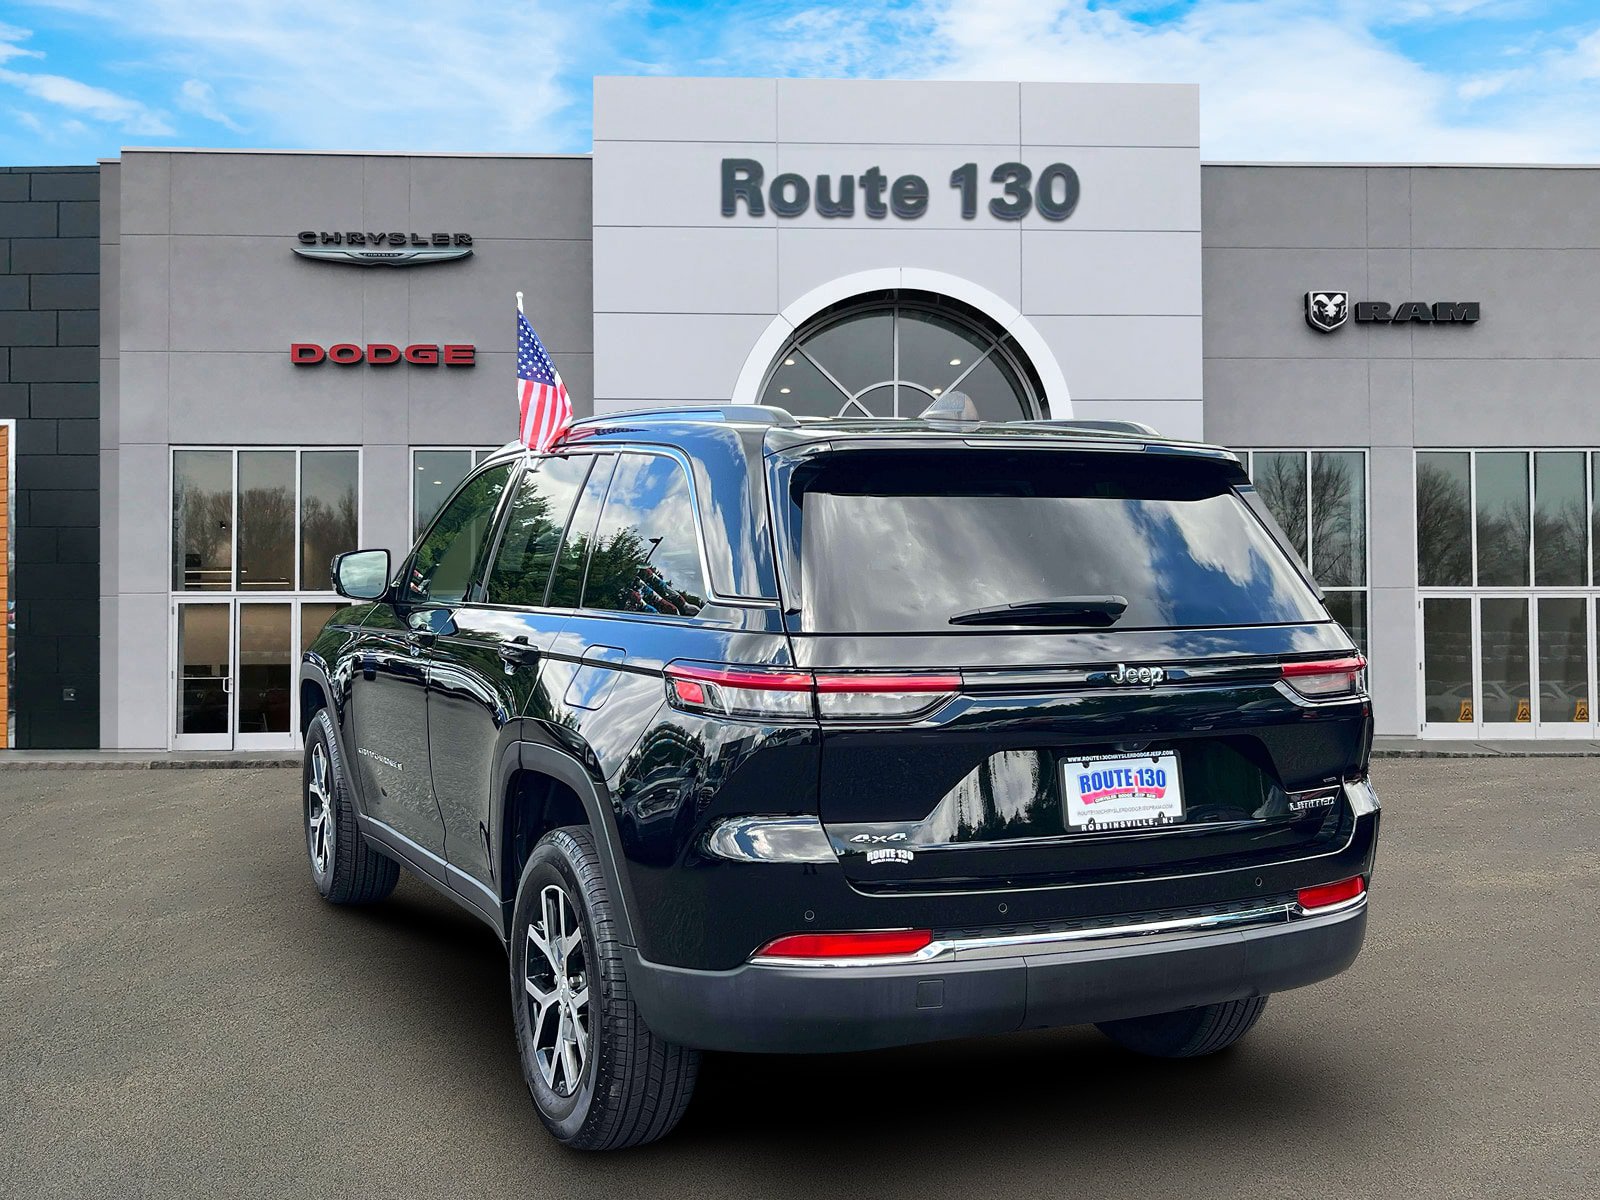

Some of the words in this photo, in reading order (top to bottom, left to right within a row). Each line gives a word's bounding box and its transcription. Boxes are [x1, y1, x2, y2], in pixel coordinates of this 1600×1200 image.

[721, 158, 930, 218] Route
[950, 162, 1081, 221] 130
[298, 231, 473, 246] CHRYSLER
[1354, 301, 1481, 325] RAM
[290, 343, 476, 366] DODGE
[1110, 663, 1164, 688] Jeep
[1078, 768, 1135, 794] ROUTE
[1135, 768, 1167, 788] 130
[1081, 818, 1158, 832] ROBBINSVILLE,
[1162, 816, 1174, 824] NJ
[866, 848, 896, 862] ROUTE
[896, 849, 914, 861] 130
